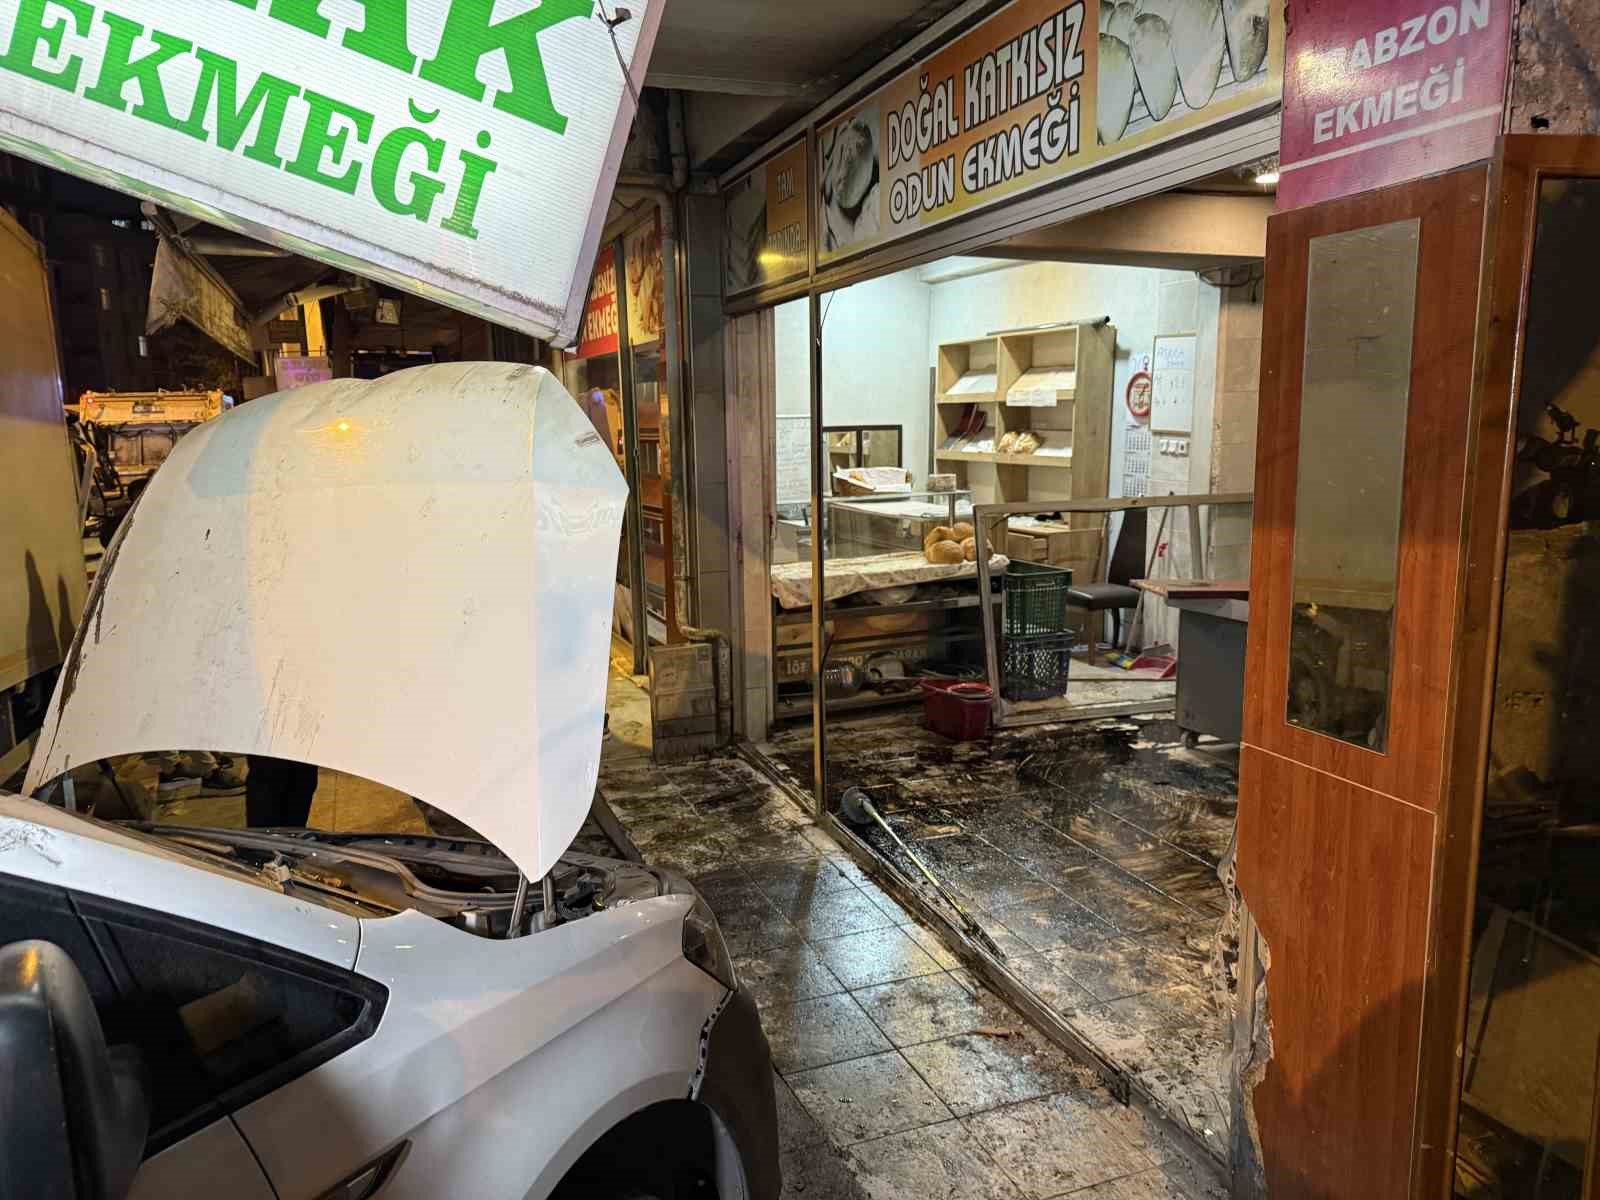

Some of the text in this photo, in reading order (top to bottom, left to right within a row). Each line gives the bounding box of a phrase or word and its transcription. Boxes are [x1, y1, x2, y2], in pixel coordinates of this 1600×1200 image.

[0, 0, 497, 240] EKMEĞİ
[888, 1, 1085, 170] DOĞAL KATKISIZ
[889, 82, 1080, 223] ODUN EKMEĞİ
[1313, 57, 1466, 144] EKMEĞİ
